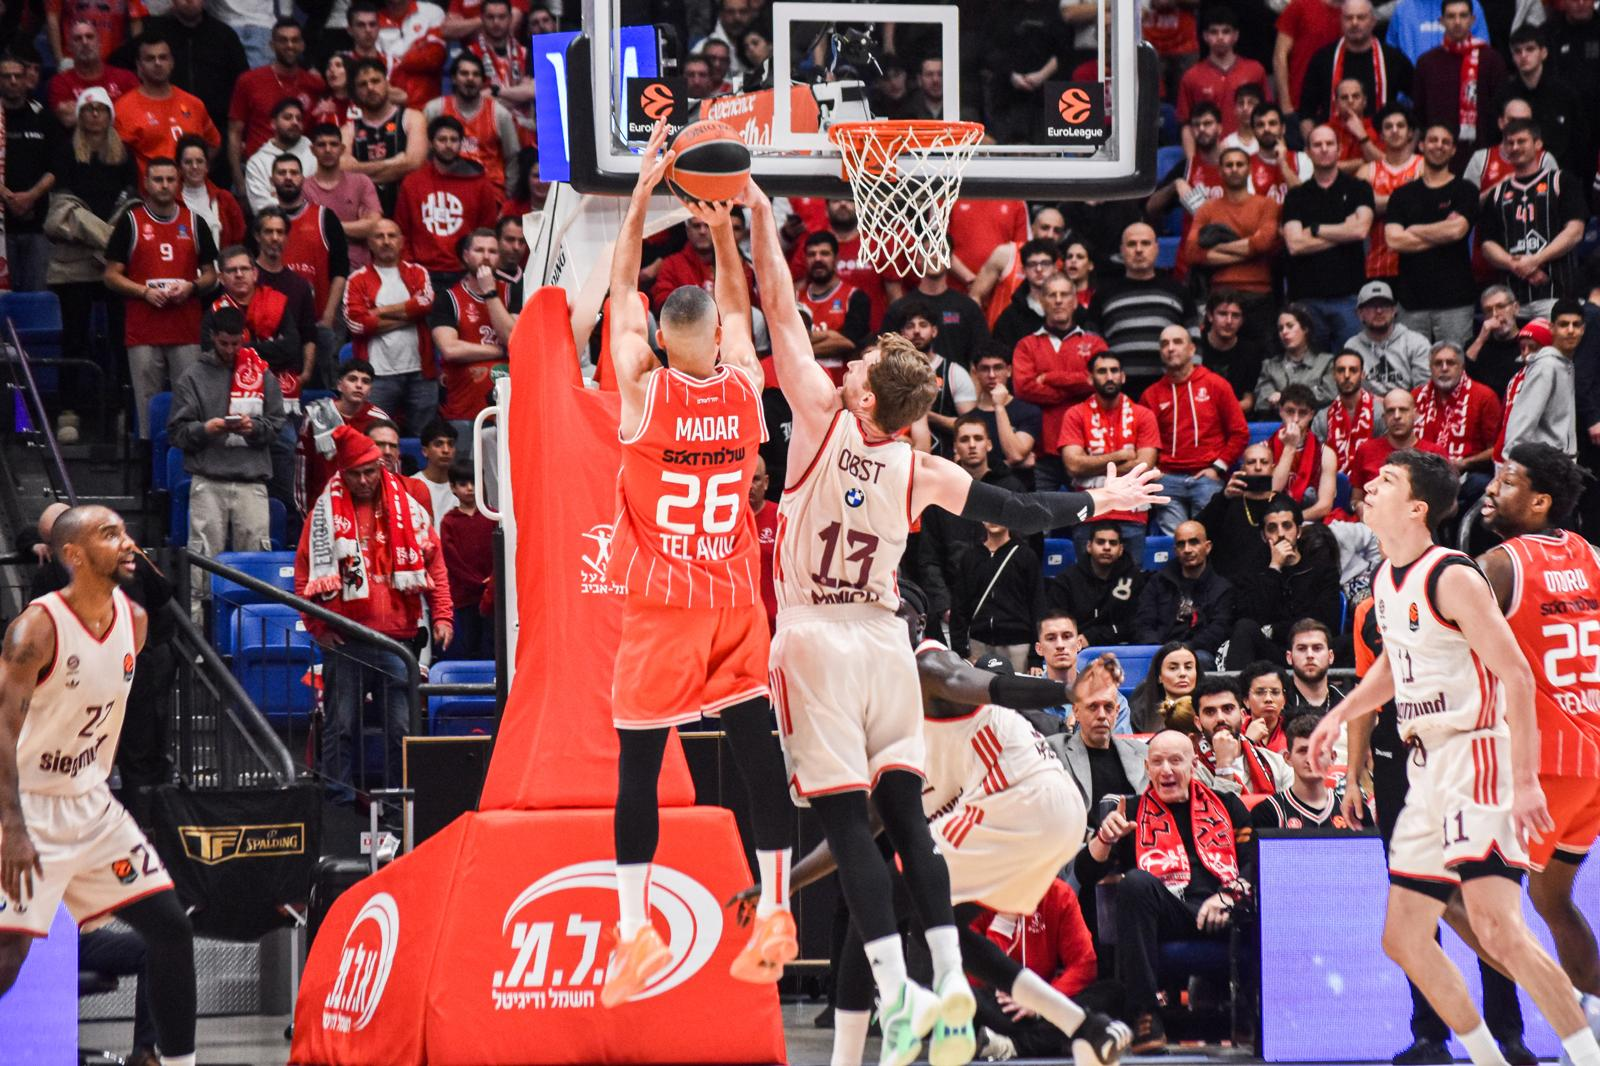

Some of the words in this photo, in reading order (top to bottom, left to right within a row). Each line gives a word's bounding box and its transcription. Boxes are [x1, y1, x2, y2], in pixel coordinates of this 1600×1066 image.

[629, 122, 684, 135] EuroLgu
[1047, 126, 1103, 139] EuroLeague
[160, 243, 173, 261] 9
[675, 415, 740, 442] MADAR
[838, 448, 886, 484] OBST
[655, 469, 744, 535] 26
[659, 533, 693, 560] TEL
[696, 534, 736, 561] AVIV
[811, 521, 880, 589] 13
[1542, 619, 1600, 687] 25
[246, 834, 298, 852] SPALDING
[491, 988, 546, 1011] ודיגיטל
[549, 988, 595, 1008] חשמל
